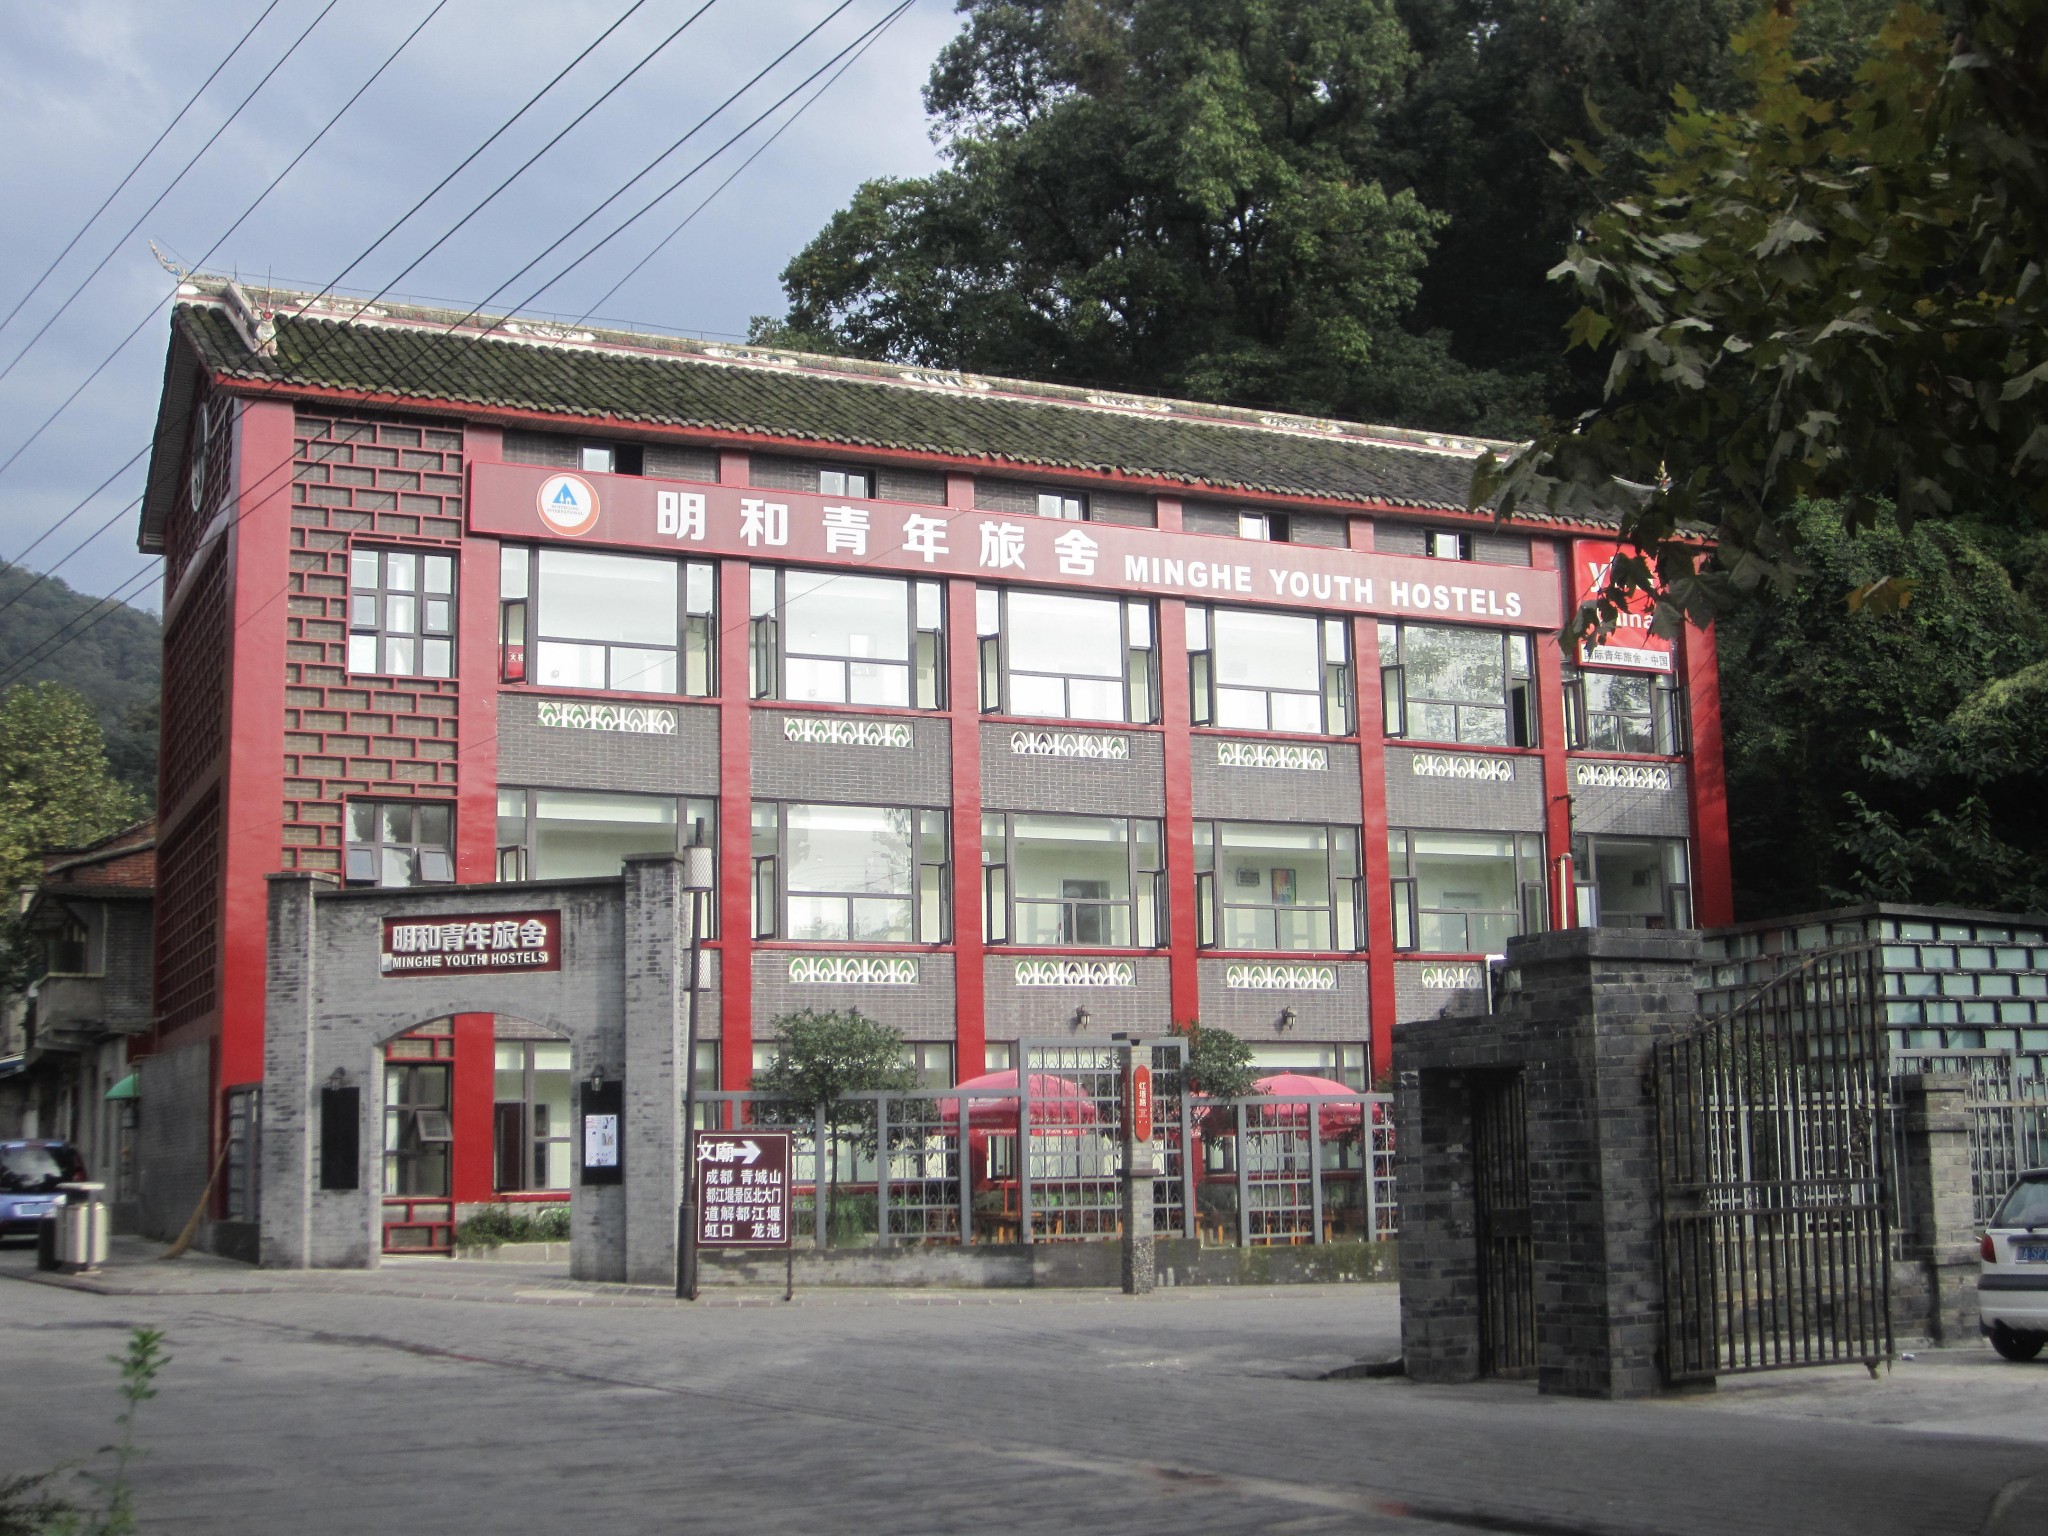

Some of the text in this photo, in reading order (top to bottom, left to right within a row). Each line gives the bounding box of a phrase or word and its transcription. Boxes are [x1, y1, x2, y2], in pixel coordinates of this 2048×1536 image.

[657, 491, 1098, 576] 明和青年旅舍
[1125, 555, 1522, 617] MINGHE YOUTH HOSTELS
[392, 919, 547, 952] 明和青年旅舍
[392, 951, 548, 968] MINGHE YOUTH HOSTELS
[705, 1169, 781, 1185] 成都 青城山
[706, 1187, 781, 1204] 都江堰景区北大门
[704, 1206, 781, 1222] 道解都江堰
[704, 1223, 781, 1238] 虹口 龙池
